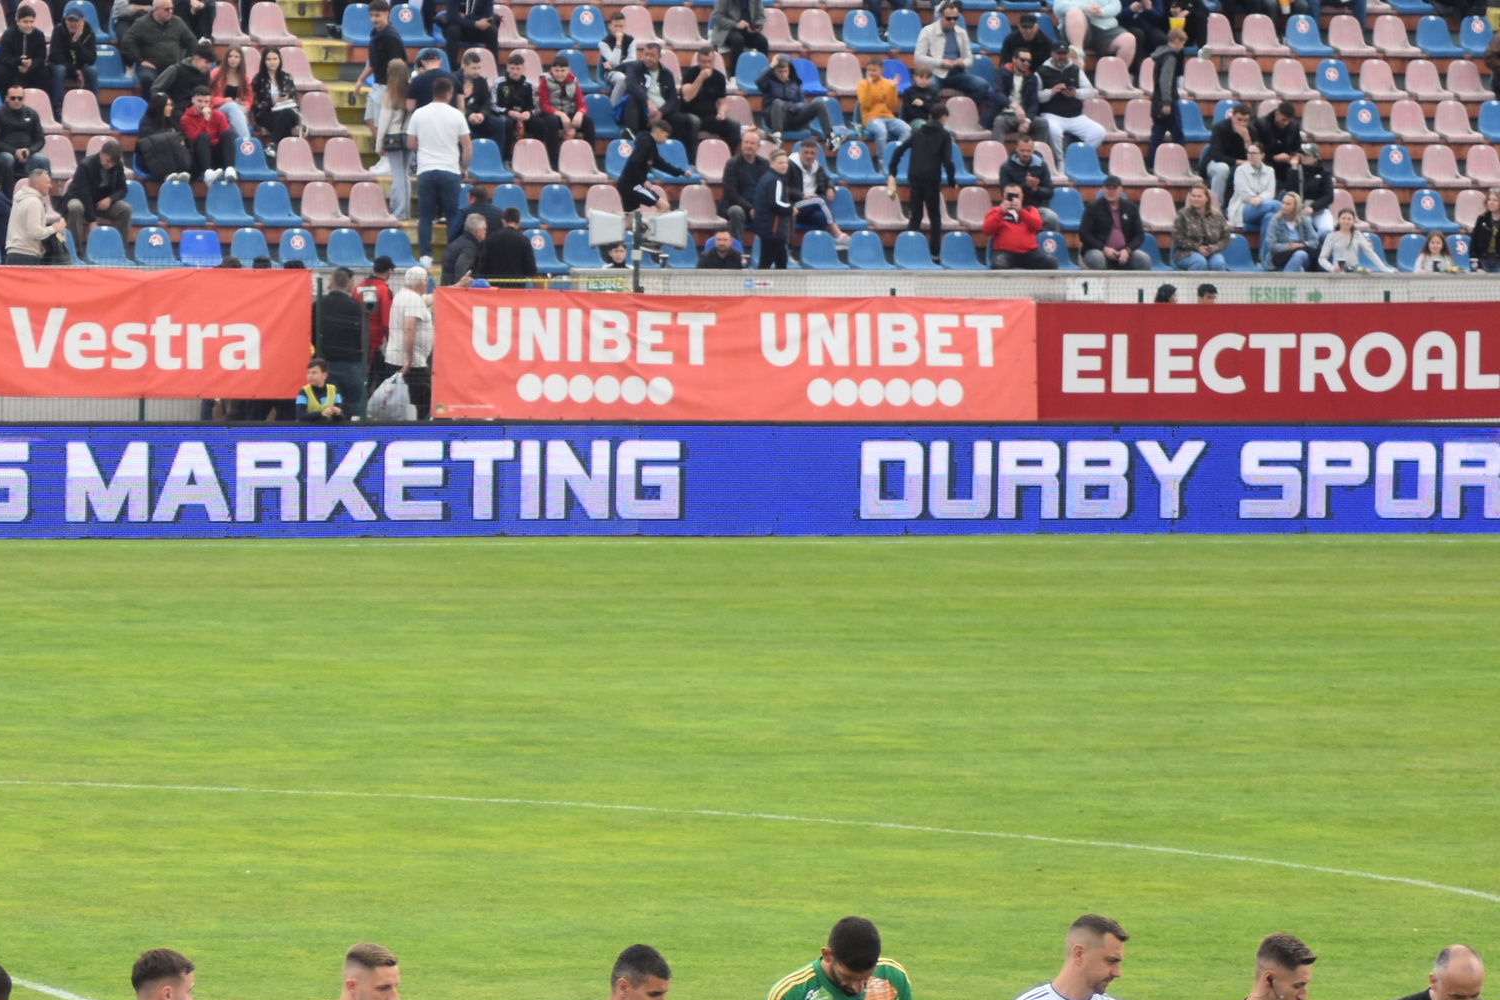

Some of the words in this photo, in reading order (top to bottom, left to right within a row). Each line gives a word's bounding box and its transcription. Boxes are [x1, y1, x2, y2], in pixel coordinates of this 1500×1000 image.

[10, 306, 261, 371] Vestra
[471, 306, 717, 366] UNIBET
[760, 312, 1004, 368] UNIBET
[1062, 330, 1500, 394] ELECTROAL
[65, 439, 682, 523] MARKETING
[860, 440, 1206, 520] DURBY
